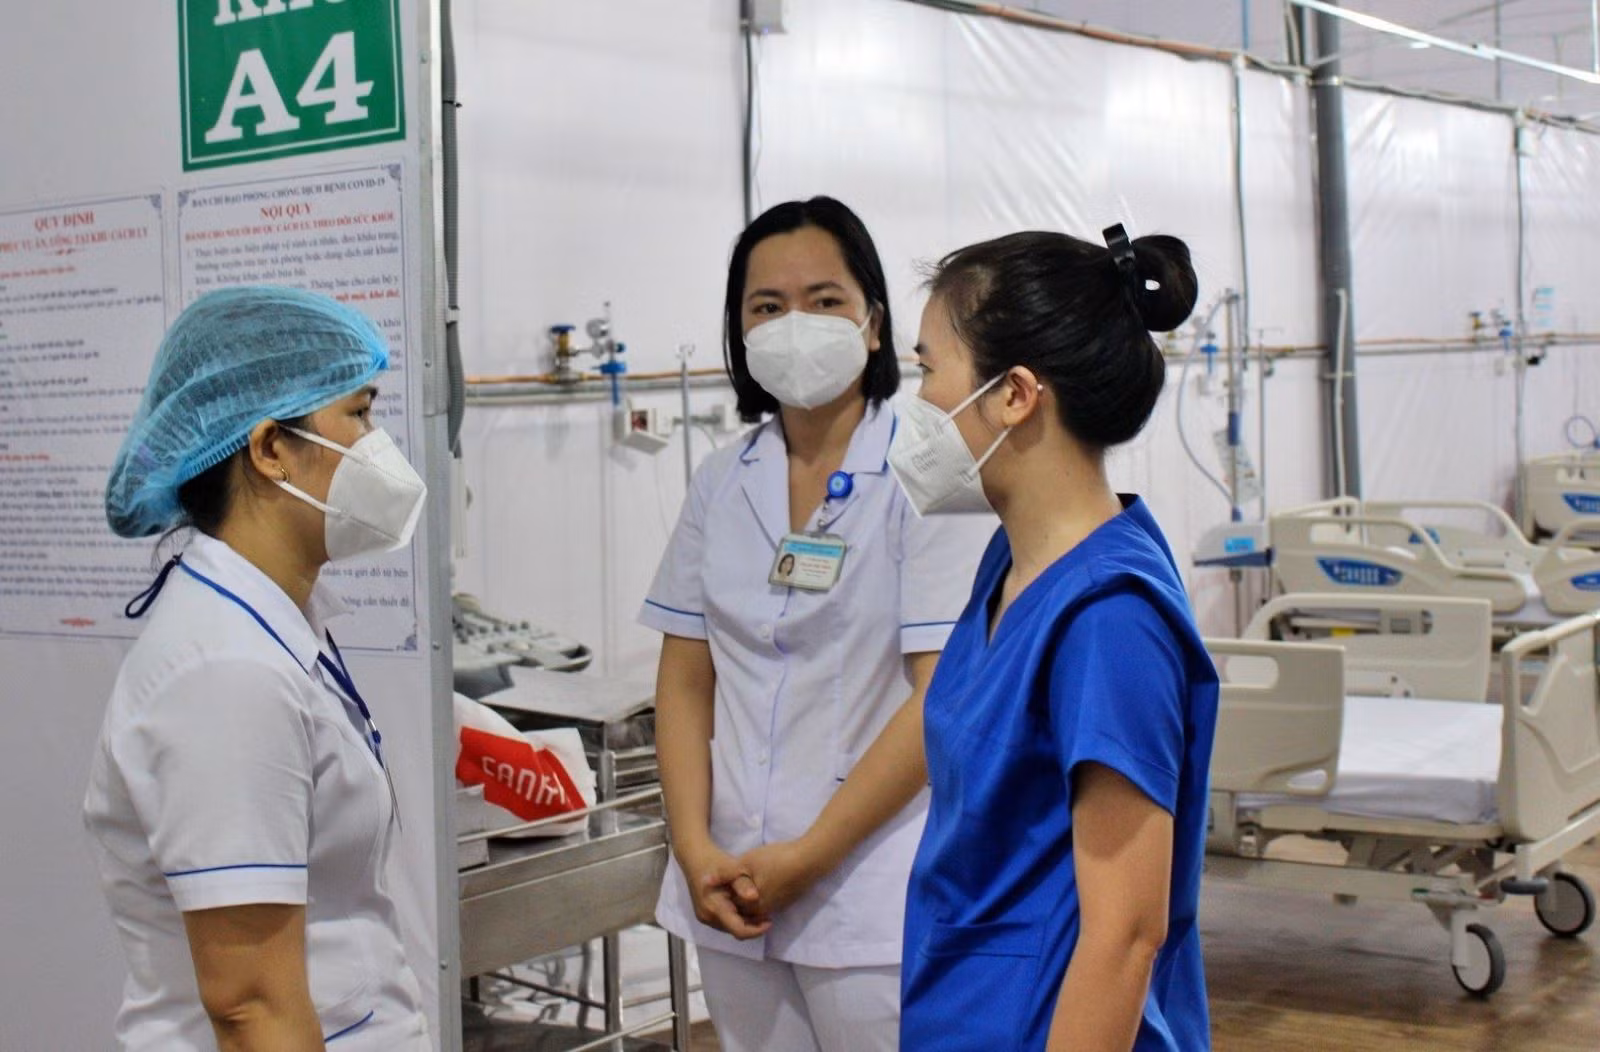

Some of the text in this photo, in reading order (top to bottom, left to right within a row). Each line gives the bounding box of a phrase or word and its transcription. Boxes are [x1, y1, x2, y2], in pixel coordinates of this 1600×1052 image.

[205, 31, 375, 144] A4
[324, 181, 346, 193] BỆNH
[347, 177, 385, 190] COVID-19
[261, 202, 312, 220] NỘI QUY
[34, 210, 95, 233] QUY ĐỊNH
[312, 216, 336, 230] THEO
[356, 230, 377, 243] khẩu
[375, 243, 399, 256] khuẩn
[310, 278, 335, 291] Thông
[369, 566, 382, 577] đồ
[393, 566, 409, 577] bên
